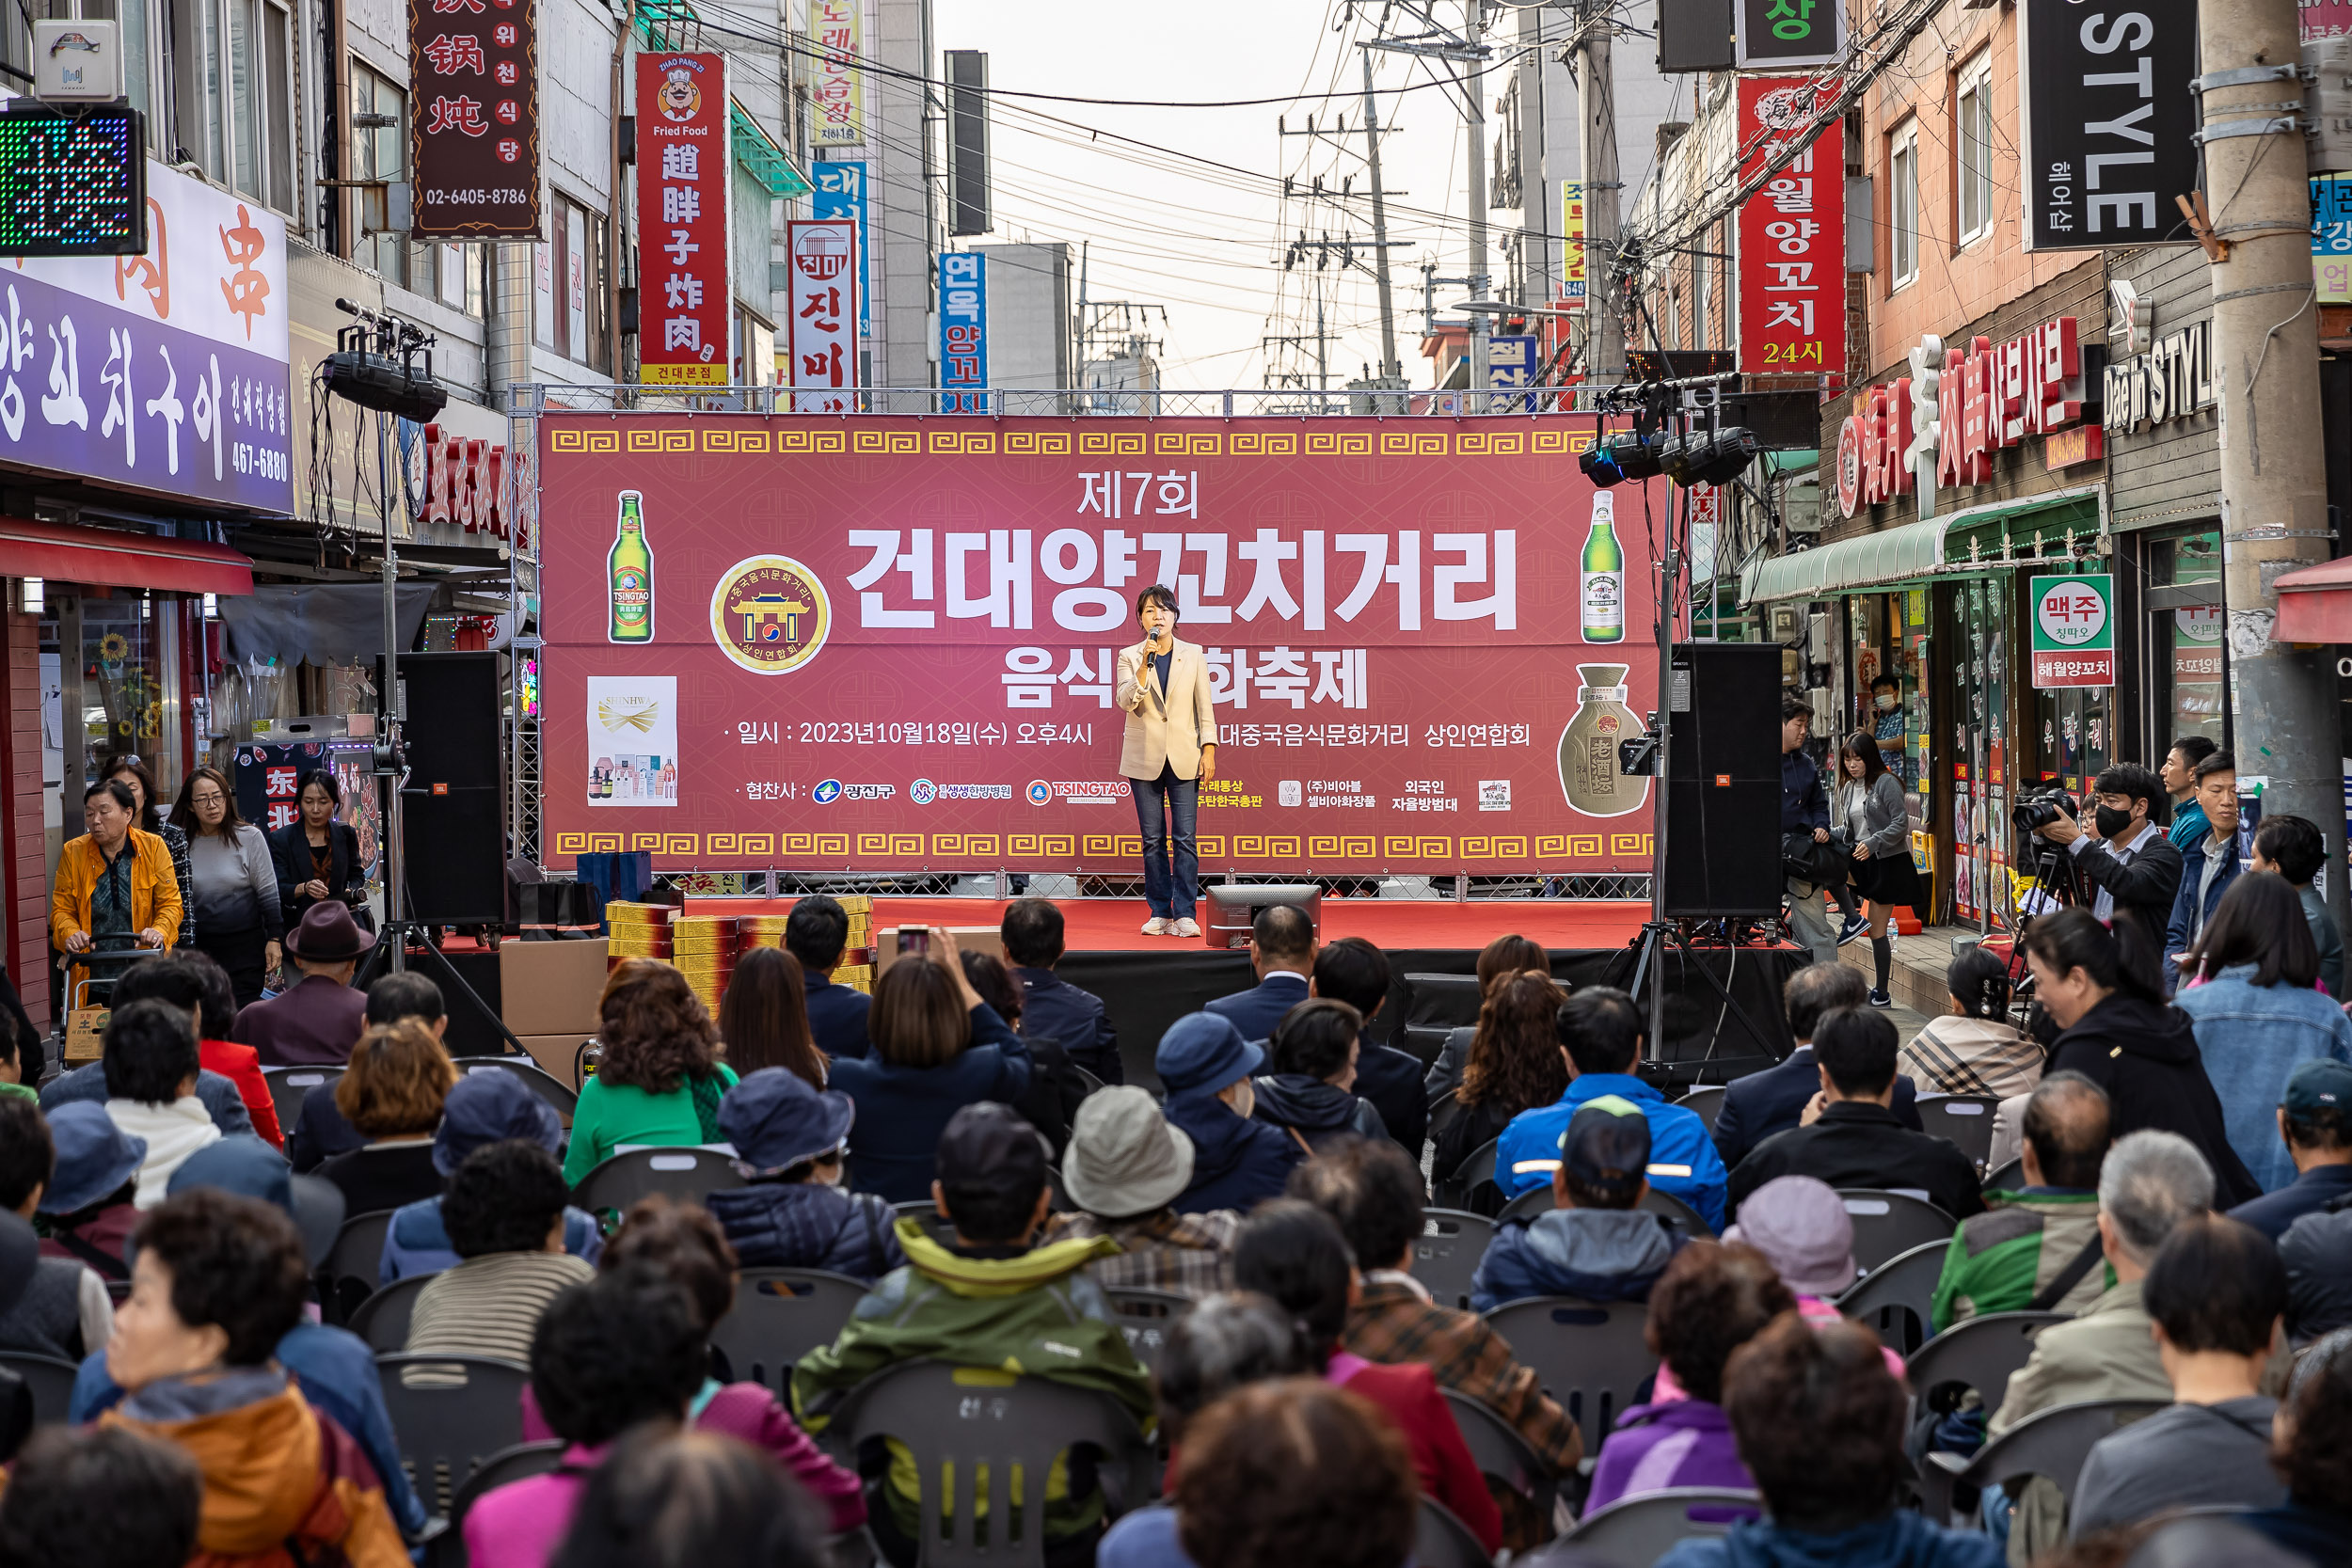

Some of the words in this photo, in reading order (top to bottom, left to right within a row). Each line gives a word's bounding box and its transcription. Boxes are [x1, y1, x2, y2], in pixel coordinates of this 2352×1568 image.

[659, 57, 678, 72] ZHAO
[678, 57, 697, 68] PANG
[696, 64, 706, 73] ZI
[653, 125, 680, 136] Fried
[682, 125, 707, 136] Food
[2080, 12, 2156, 232] STYLE
[426, 188, 527, 205] 02-6405-8786
[660, 142, 704, 352] 趙胖子炸肉
[803, 256, 842, 276] 진미
[1763, 341, 1822, 365] 24시
[658, 366, 711, 379] 건대본점
[2104, 357, 2147, 434] Daejin
[231, 442, 287, 483] 467-6880
[1077, 470, 1198, 519] 제7회
[731, 569, 810, 597] 중국음식문화거리
[847, 529, 1517, 631] 건대양꼬치거리
[613, 592, 649, 601] TSINGTAO
[2046, 595, 2099, 623] 맥주
[2056, 627, 2090, 639] 칭따오
[742, 643, 798, 660] 상인연합회
[2039, 660, 2110, 677] 해월양꼬치
[1002, 647, 1368, 710] 음식화축제
[738, 721, 778, 745] 일시
[800, 721, 1008, 746] 2023년10월18일(수)
[1016, 721, 1092, 746] 오후4시
[1216, 722, 1409, 747] 대중국음식문화거리
[1423, 723, 1530, 748] 상인연합회
[746, 782, 797, 800] 협찬사
[844, 784, 897, 799] 광진구
[947, 784, 1011, 798] 생생한방병원
[1053, 782, 1131, 797] TSINGTAO
[1307, 779, 1362, 794] (주)비아블
[1406, 780, 1445, 795] 외국인
[1307, 795, 1376, 808] 셀비아화장품
[1392, 797, 1458, 813] 자율방범대
